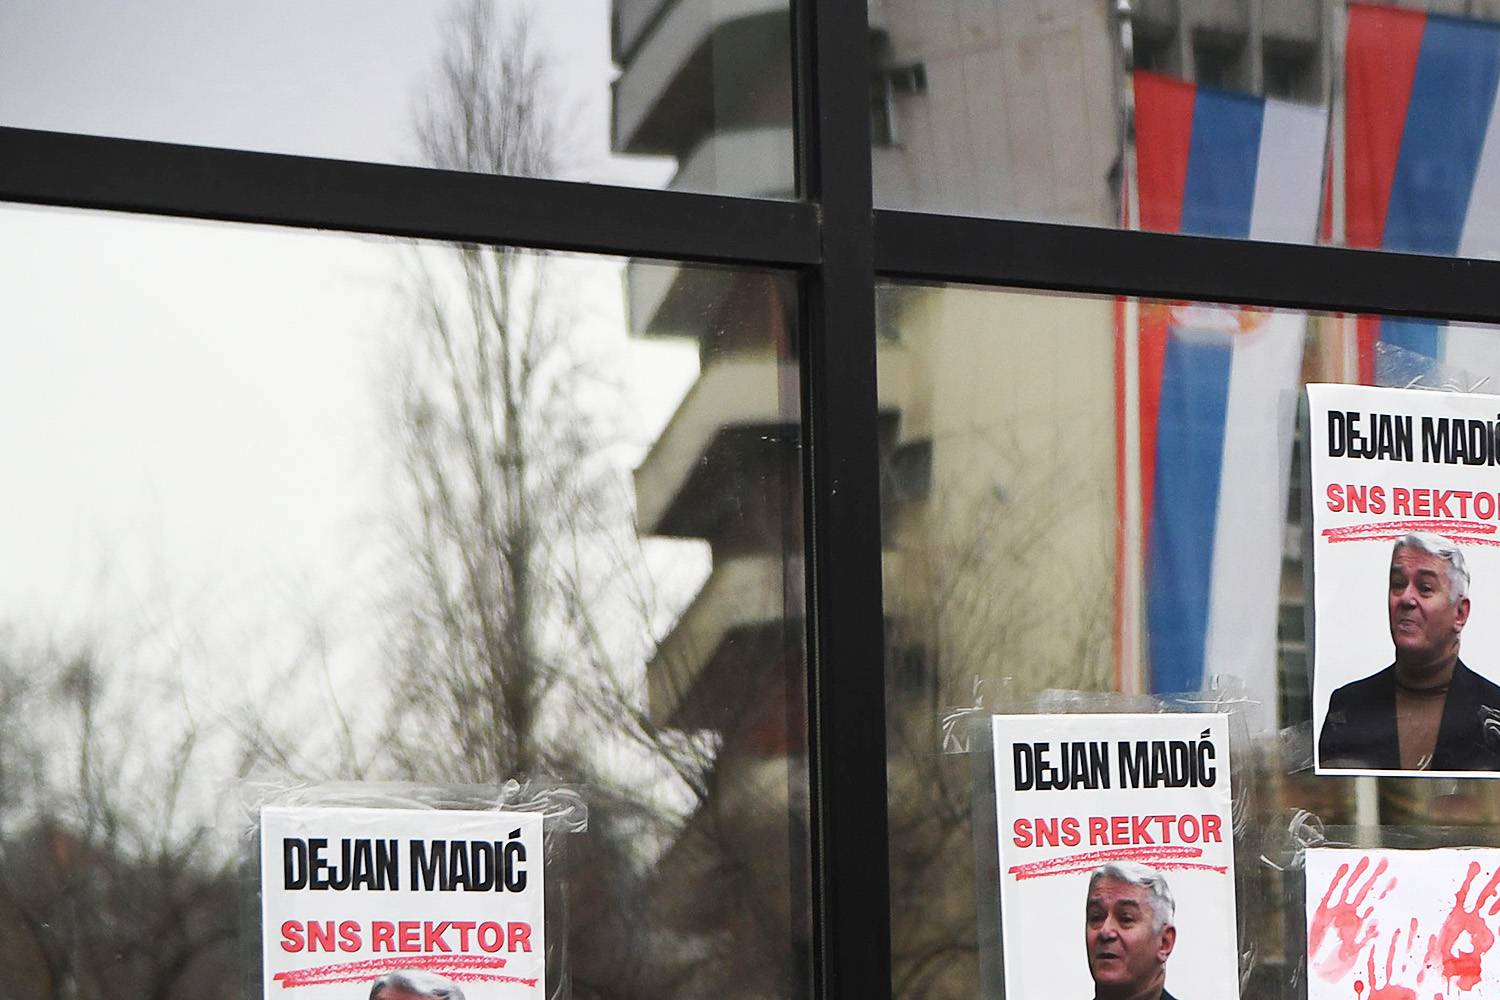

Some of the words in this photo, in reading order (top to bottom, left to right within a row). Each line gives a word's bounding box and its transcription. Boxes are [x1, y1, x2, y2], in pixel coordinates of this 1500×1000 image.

[1327, 410, 1414, 462] DEJAN
[1326, 483, 1386, 514] SNS
[1012, 741, 1111, 791] DEJAN
[1117, 728, 1216, 789] MADIĆ
[1012, 817, 1081, 848] SNS
[1089, 814, 1222, 846] REKTOR
[283, 838, 399, 891] DEJAN
[410, 827, 527, 892] MADIĆ
[280, 920, 362, 953] SNS
[371, 921, 533, 953] REKTOR
